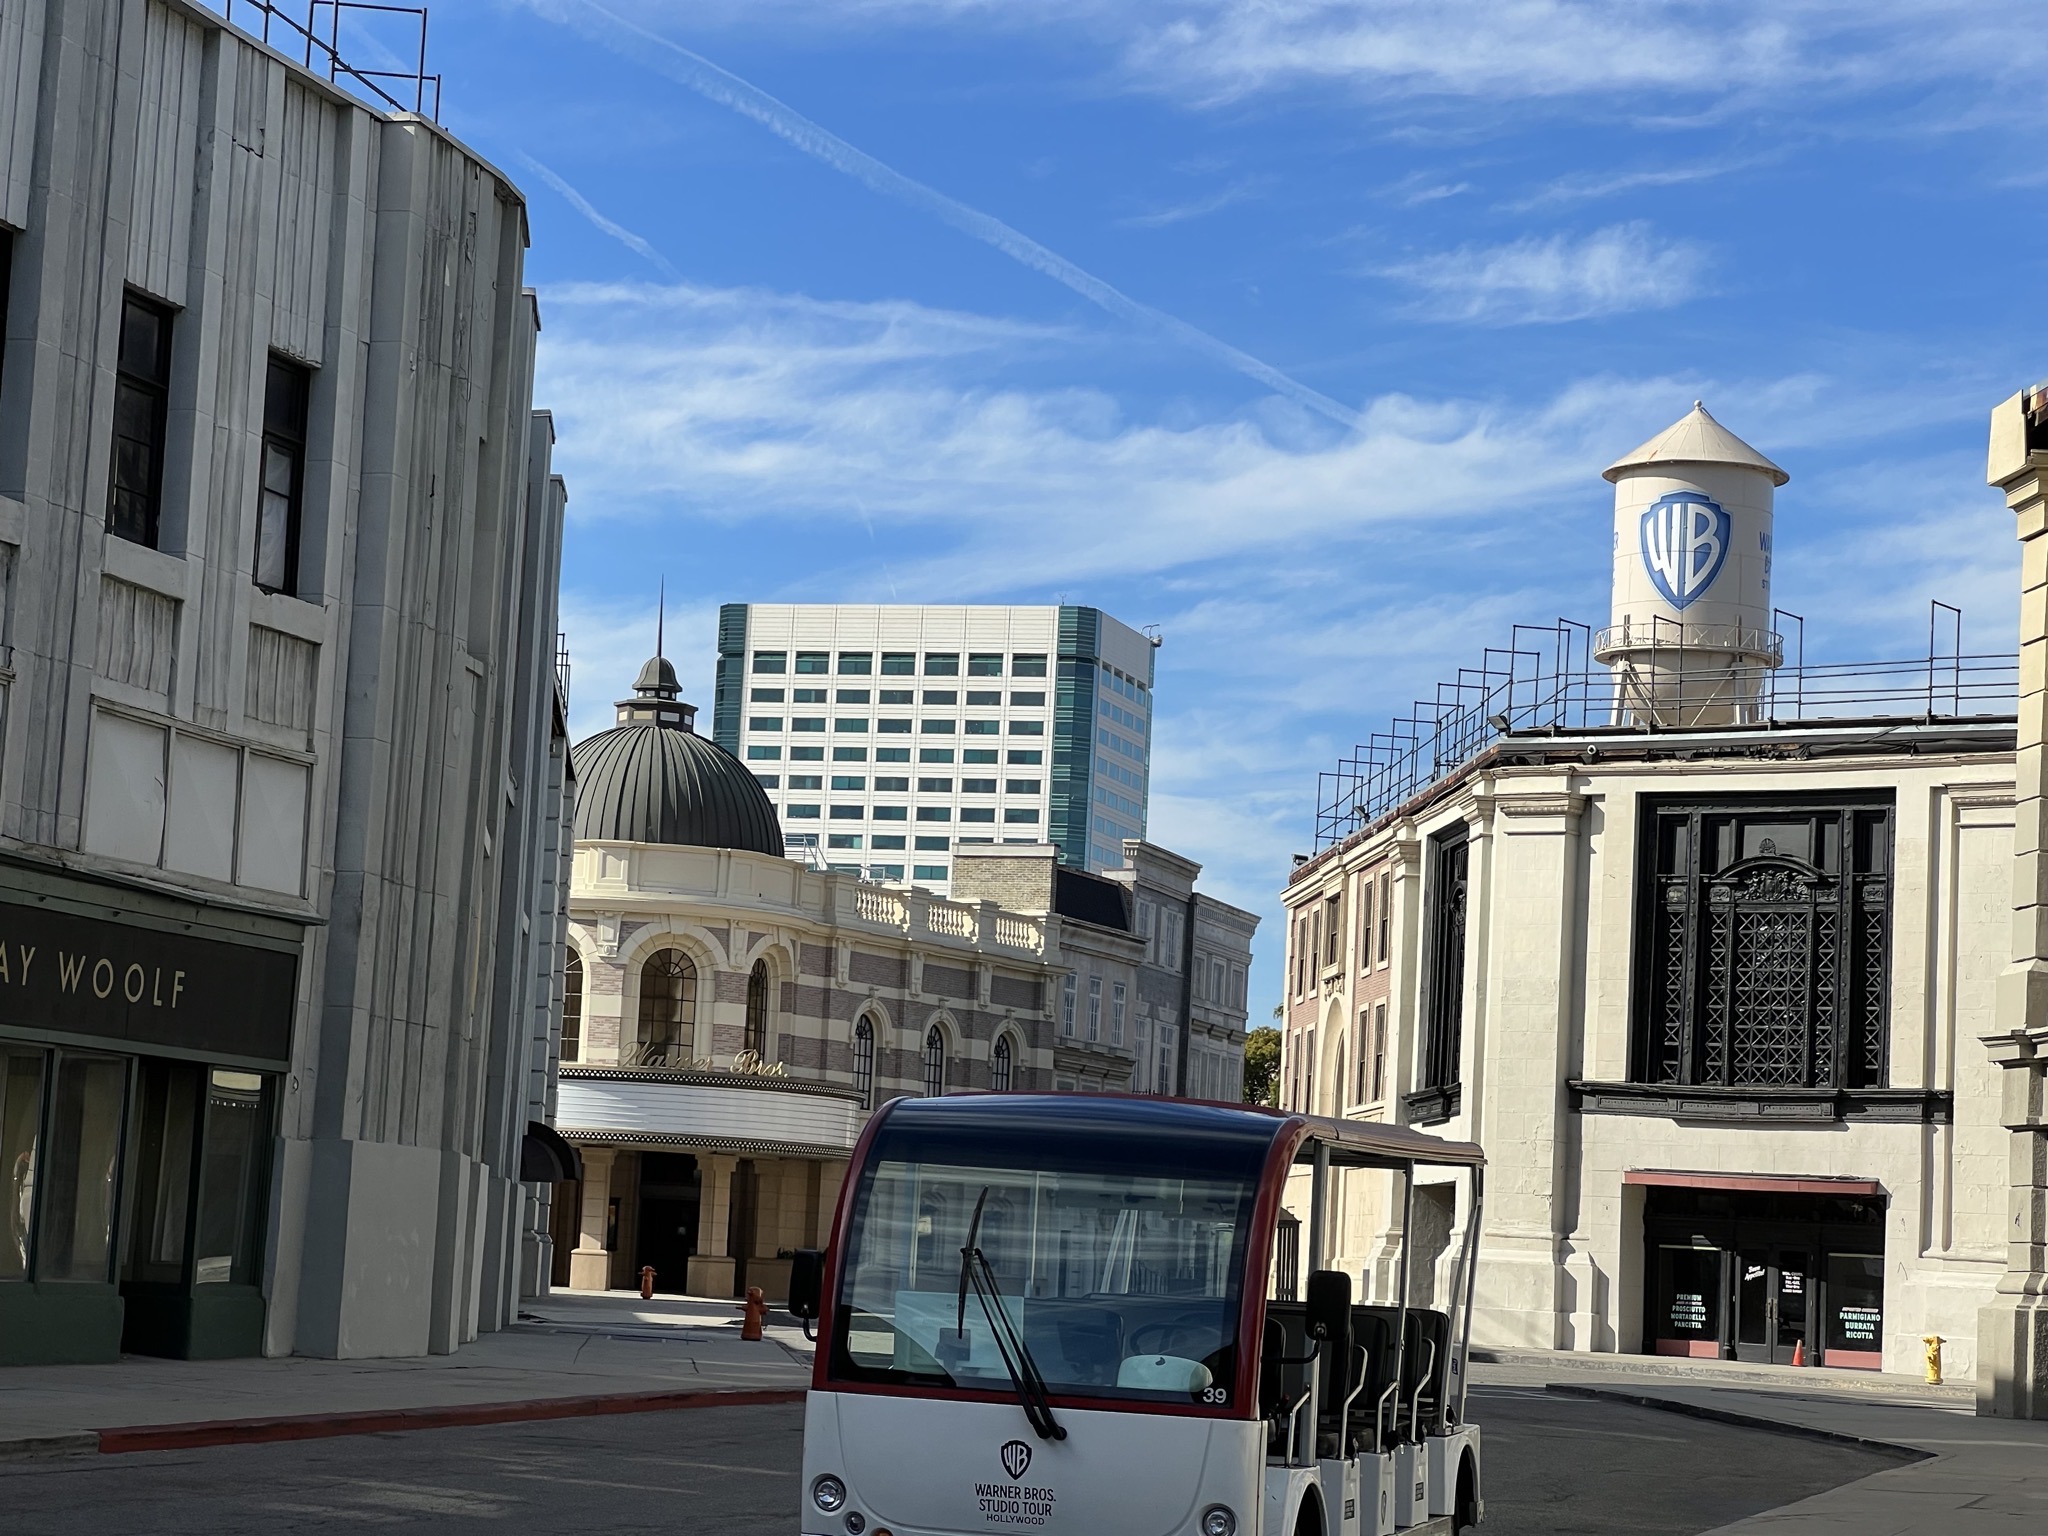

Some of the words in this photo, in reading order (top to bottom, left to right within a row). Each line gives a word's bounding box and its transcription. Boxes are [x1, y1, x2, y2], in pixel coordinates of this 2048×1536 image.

[1644, 501, 1722, 598] WB
[59, 951, 186, 1009] WOOLF
[729, 1048, 790, 1079] Bros.
[1672, 1304, 1706, 1314] PROSCIUTTO
[1839, 1311, 1881, 1322] PARMIGIANO
[1844, 1321, 1875, 1331] BURRATA
[1845, 1330, 1874, 1340] RICOTTA
[1202, 1387, 1227, 1404] 39
[1002, 1443, 1030, 1477] WB
[974, 1483, 1021, 1500] WARNER
[1024, 1486, 1057, 1502] BROS.
[979, 1499, 1020, 1514] STUDIO
[1022, 1501, 1052, 1517] TOUR
[986, 1513, 1045, 1526] HOLLYWOOD
